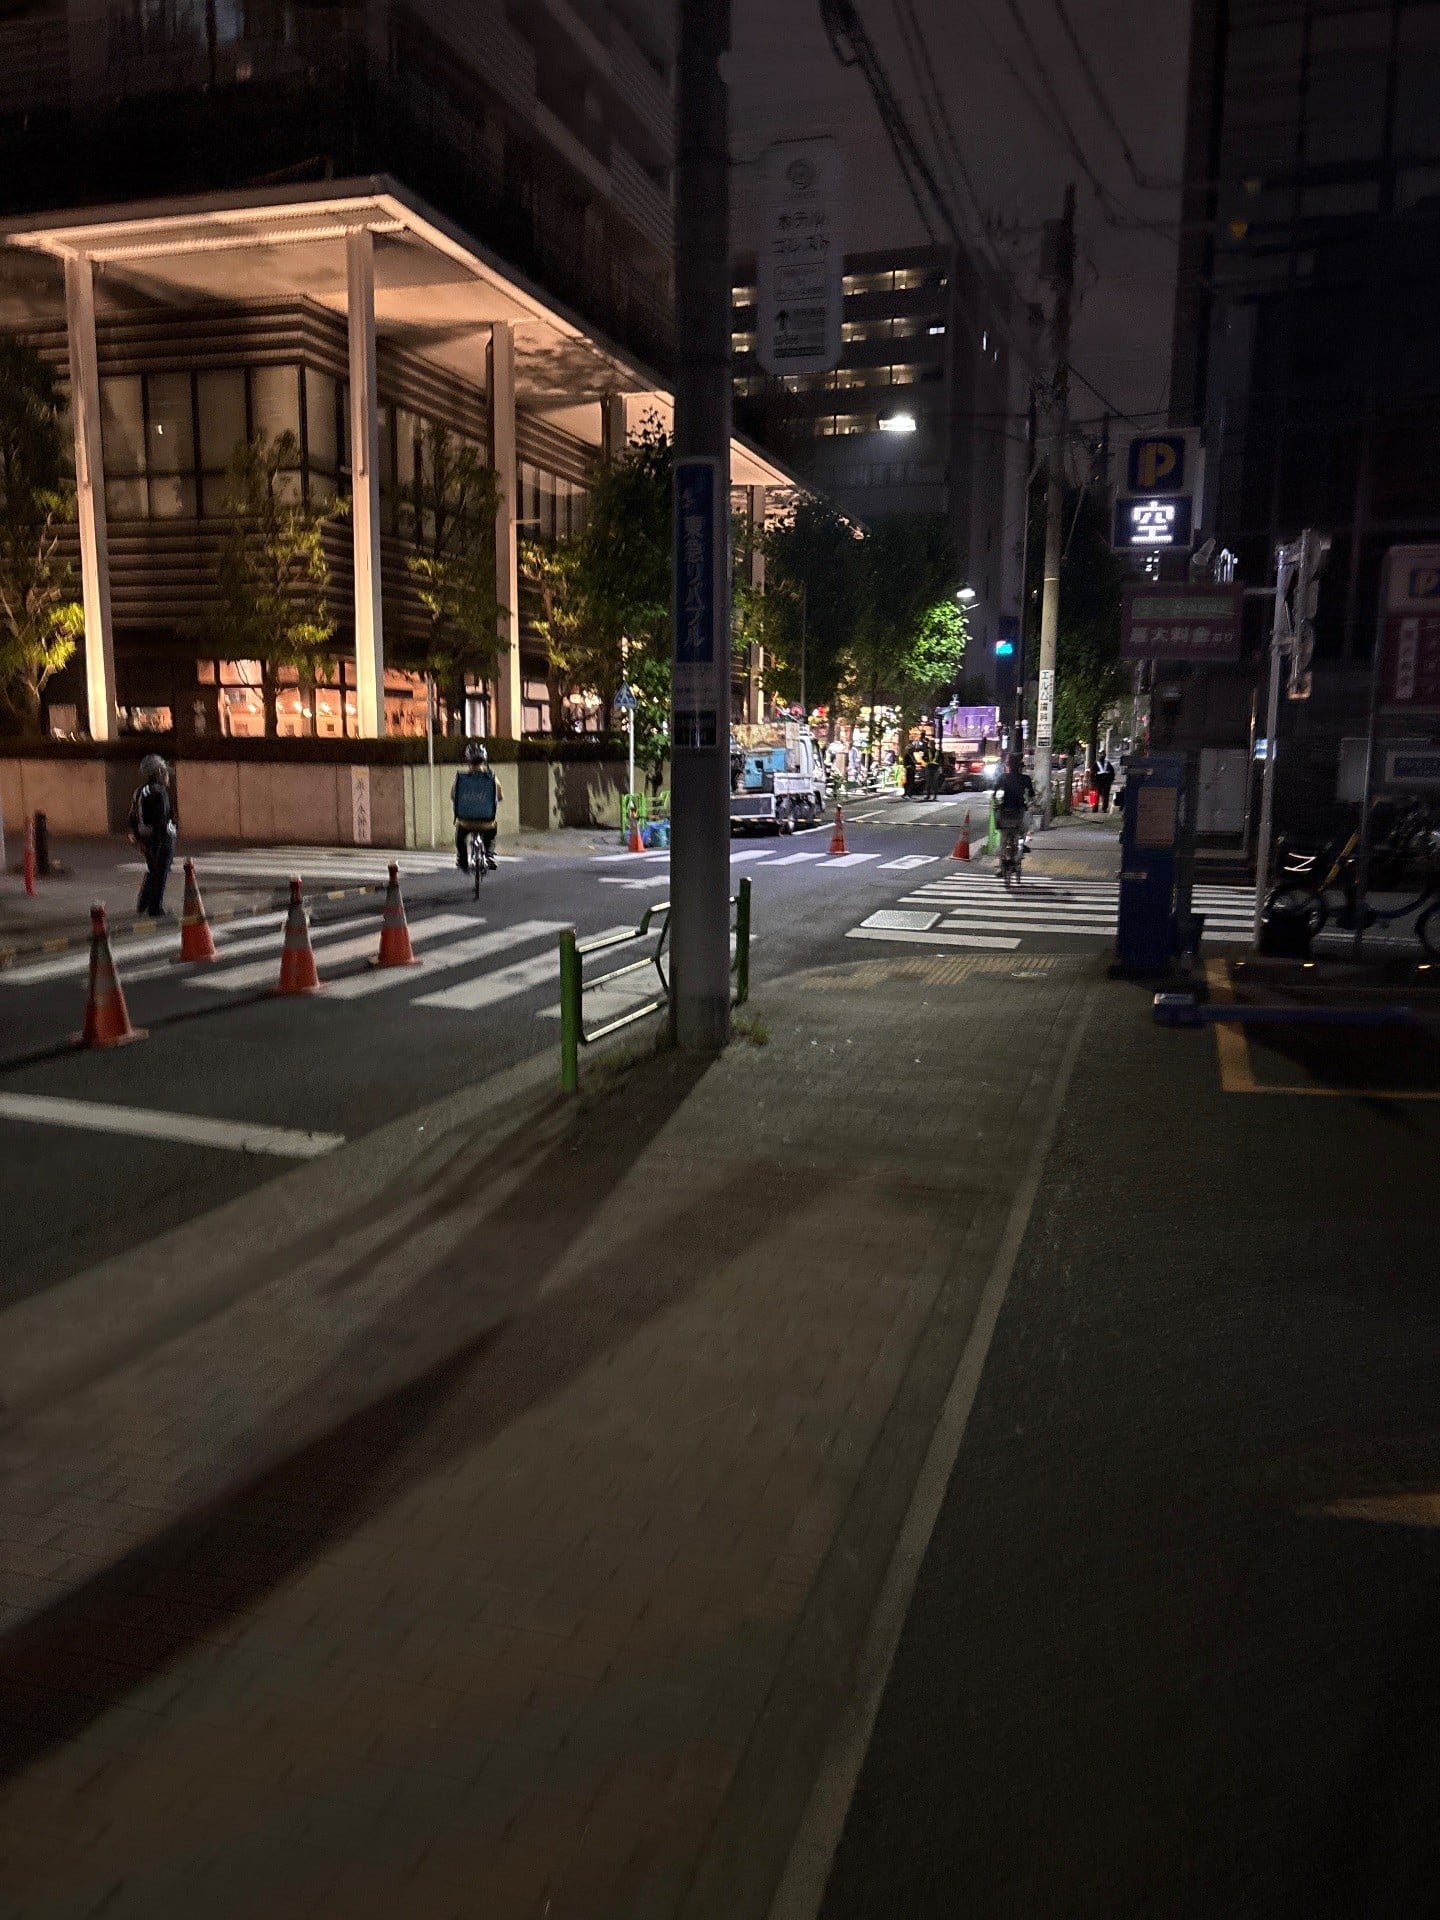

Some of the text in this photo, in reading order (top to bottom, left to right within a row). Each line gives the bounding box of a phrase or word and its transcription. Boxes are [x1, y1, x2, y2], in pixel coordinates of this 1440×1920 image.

[1137, 442, 1177, 488] P
[1130, 501, 1175, 544] 空
[684, 514, 706, 649] 東急リバブル
